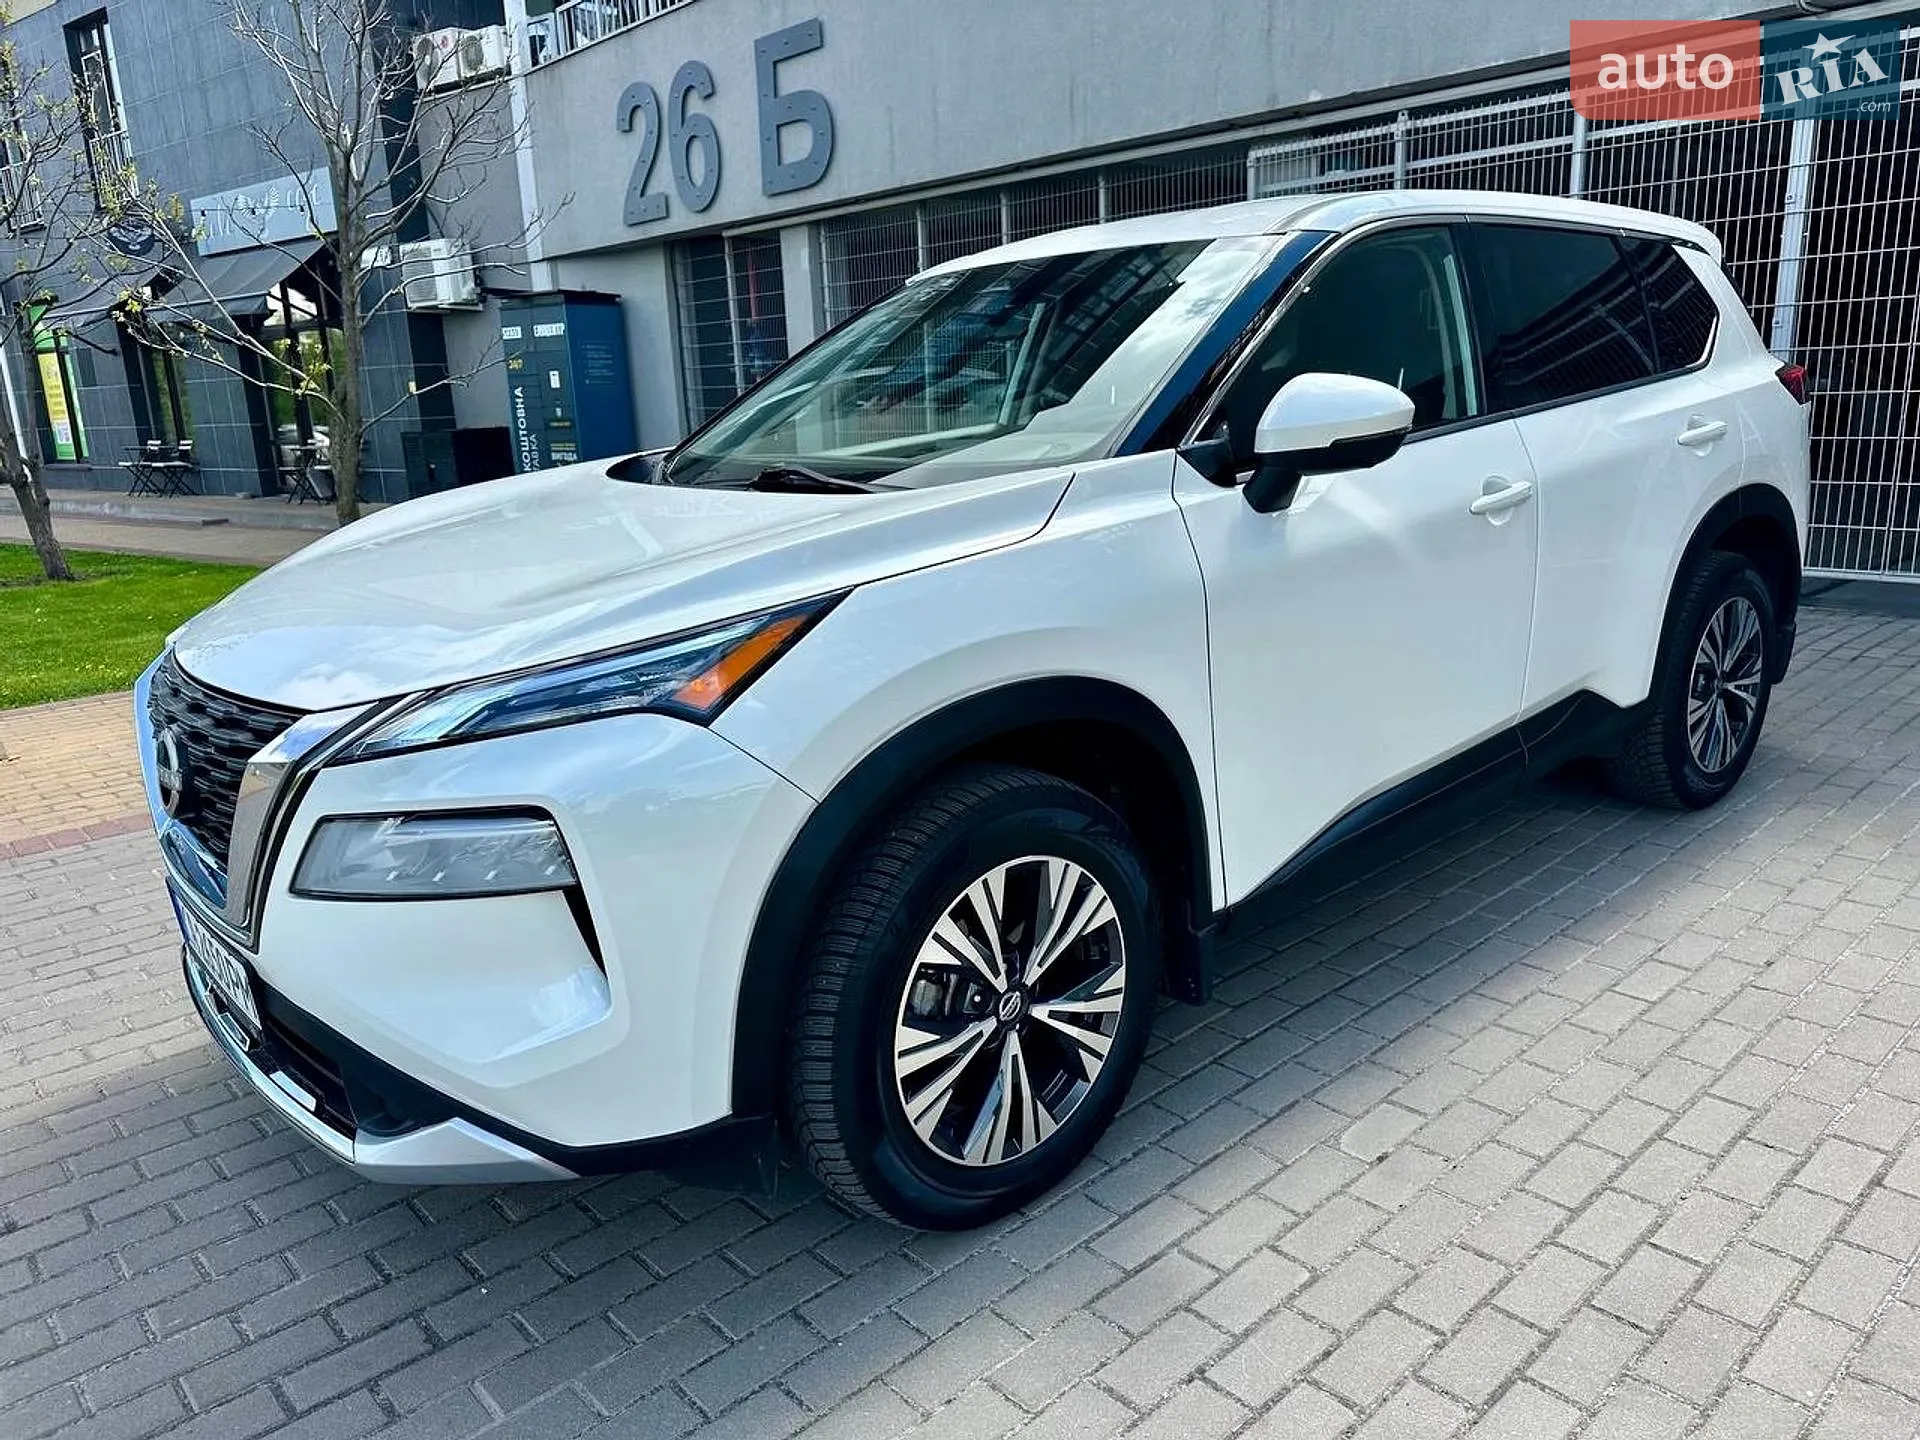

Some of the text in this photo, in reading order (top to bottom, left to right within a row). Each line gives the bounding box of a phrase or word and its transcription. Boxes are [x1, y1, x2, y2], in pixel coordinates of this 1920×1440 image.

[616, 17, 835, 227] 26 Б
[514, 386, 532, 472] КОШТОВНА
